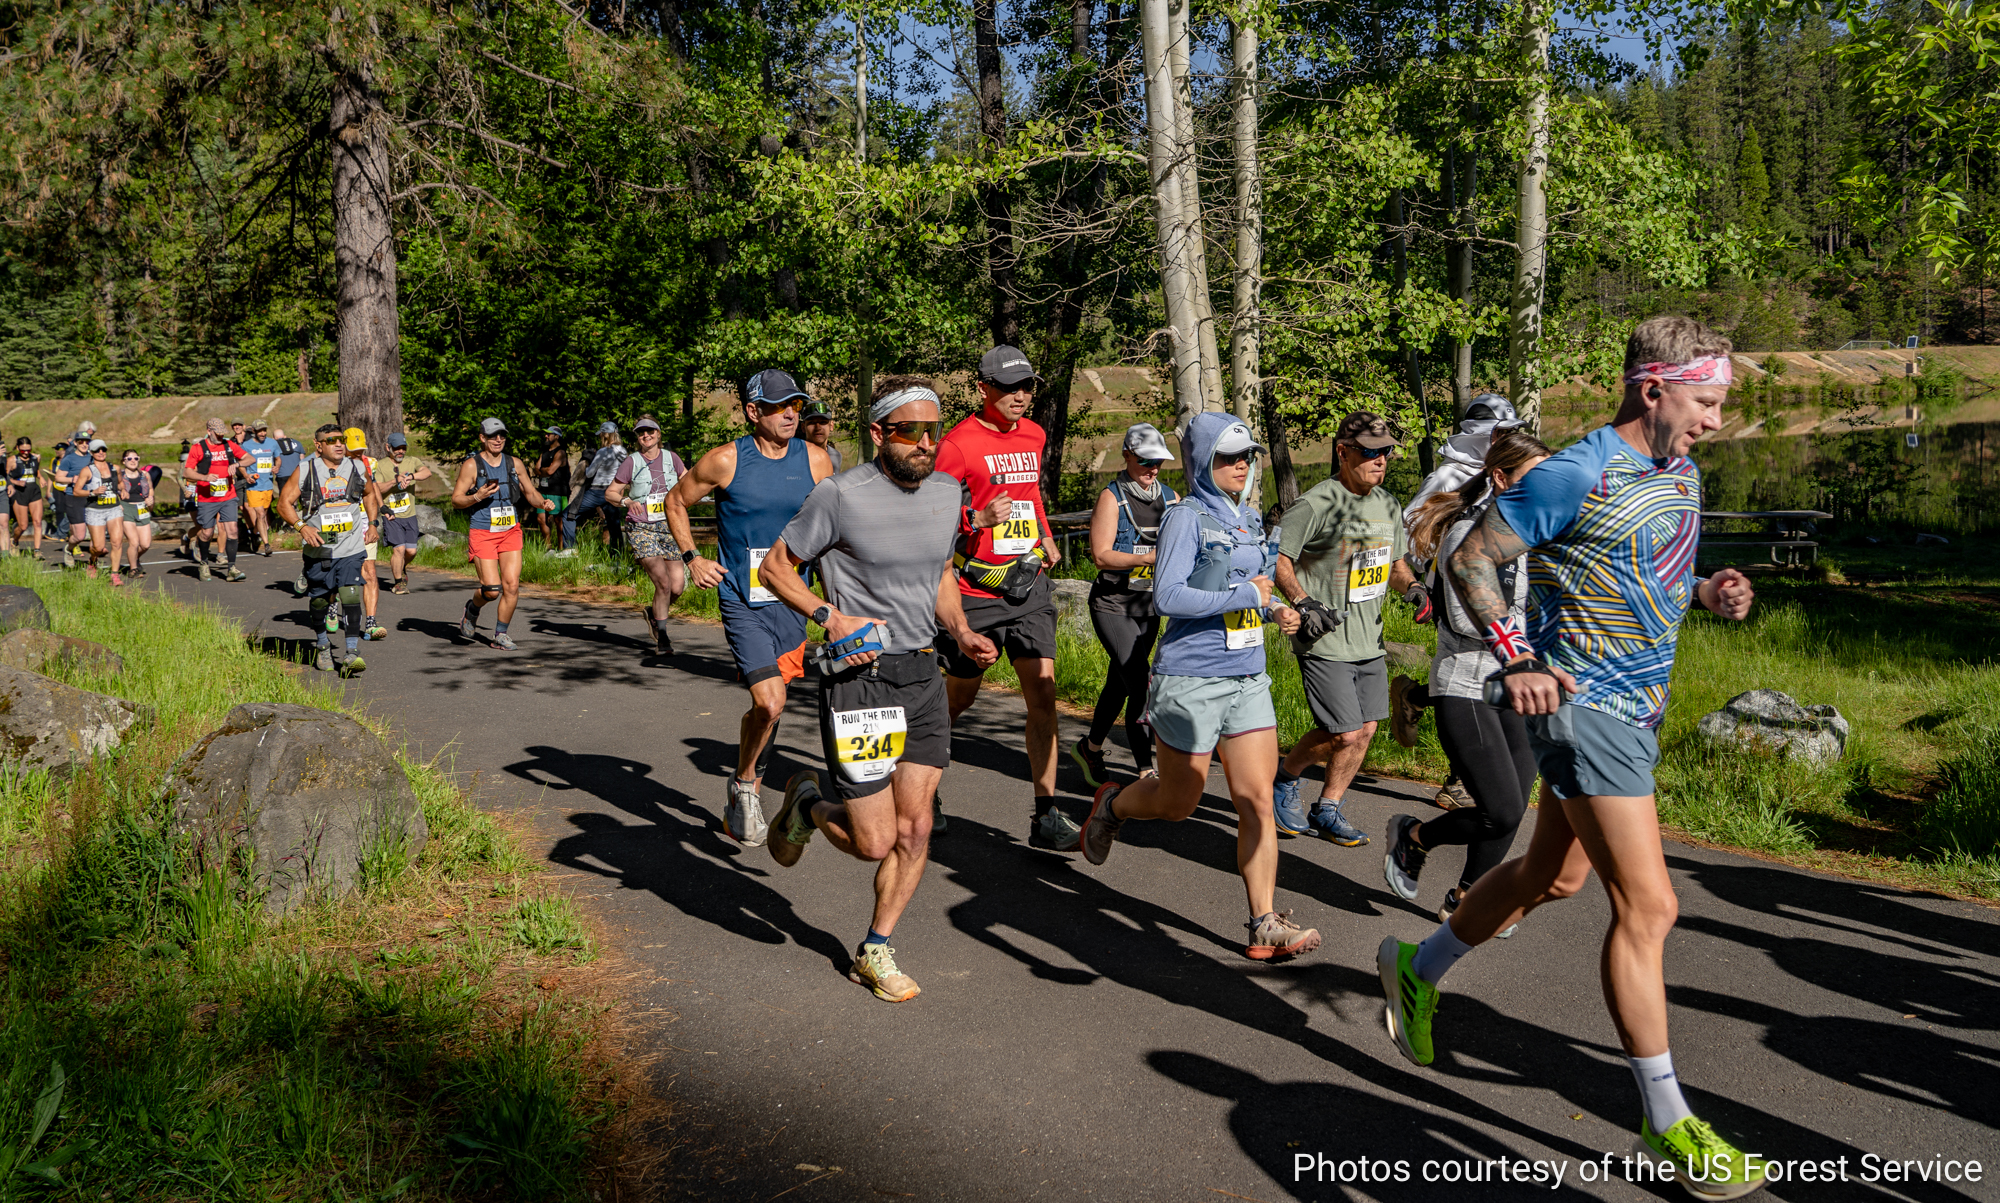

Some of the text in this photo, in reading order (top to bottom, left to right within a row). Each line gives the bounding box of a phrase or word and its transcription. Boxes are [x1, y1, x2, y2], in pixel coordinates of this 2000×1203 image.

[984, 452, 1038, 474] WISCONSIN
[1007, 474, 1037, 482] BADGERS
[1011, 502, 1020, 510] THE
[496, 516, 511, 525] 209
[328, 523, 347, 533] 231
[1003, 520, 1030, 538] 246
[1367, 550, 1376, 558] THE
[1377, 548, 1387, 557] RIM
[1365, 558, 1377, 567] 21K
[1358, 566, 1382, 587] 238
[842, 710, 898, 724] RUN THE RIM
[851, 733, 893, 761] 234
